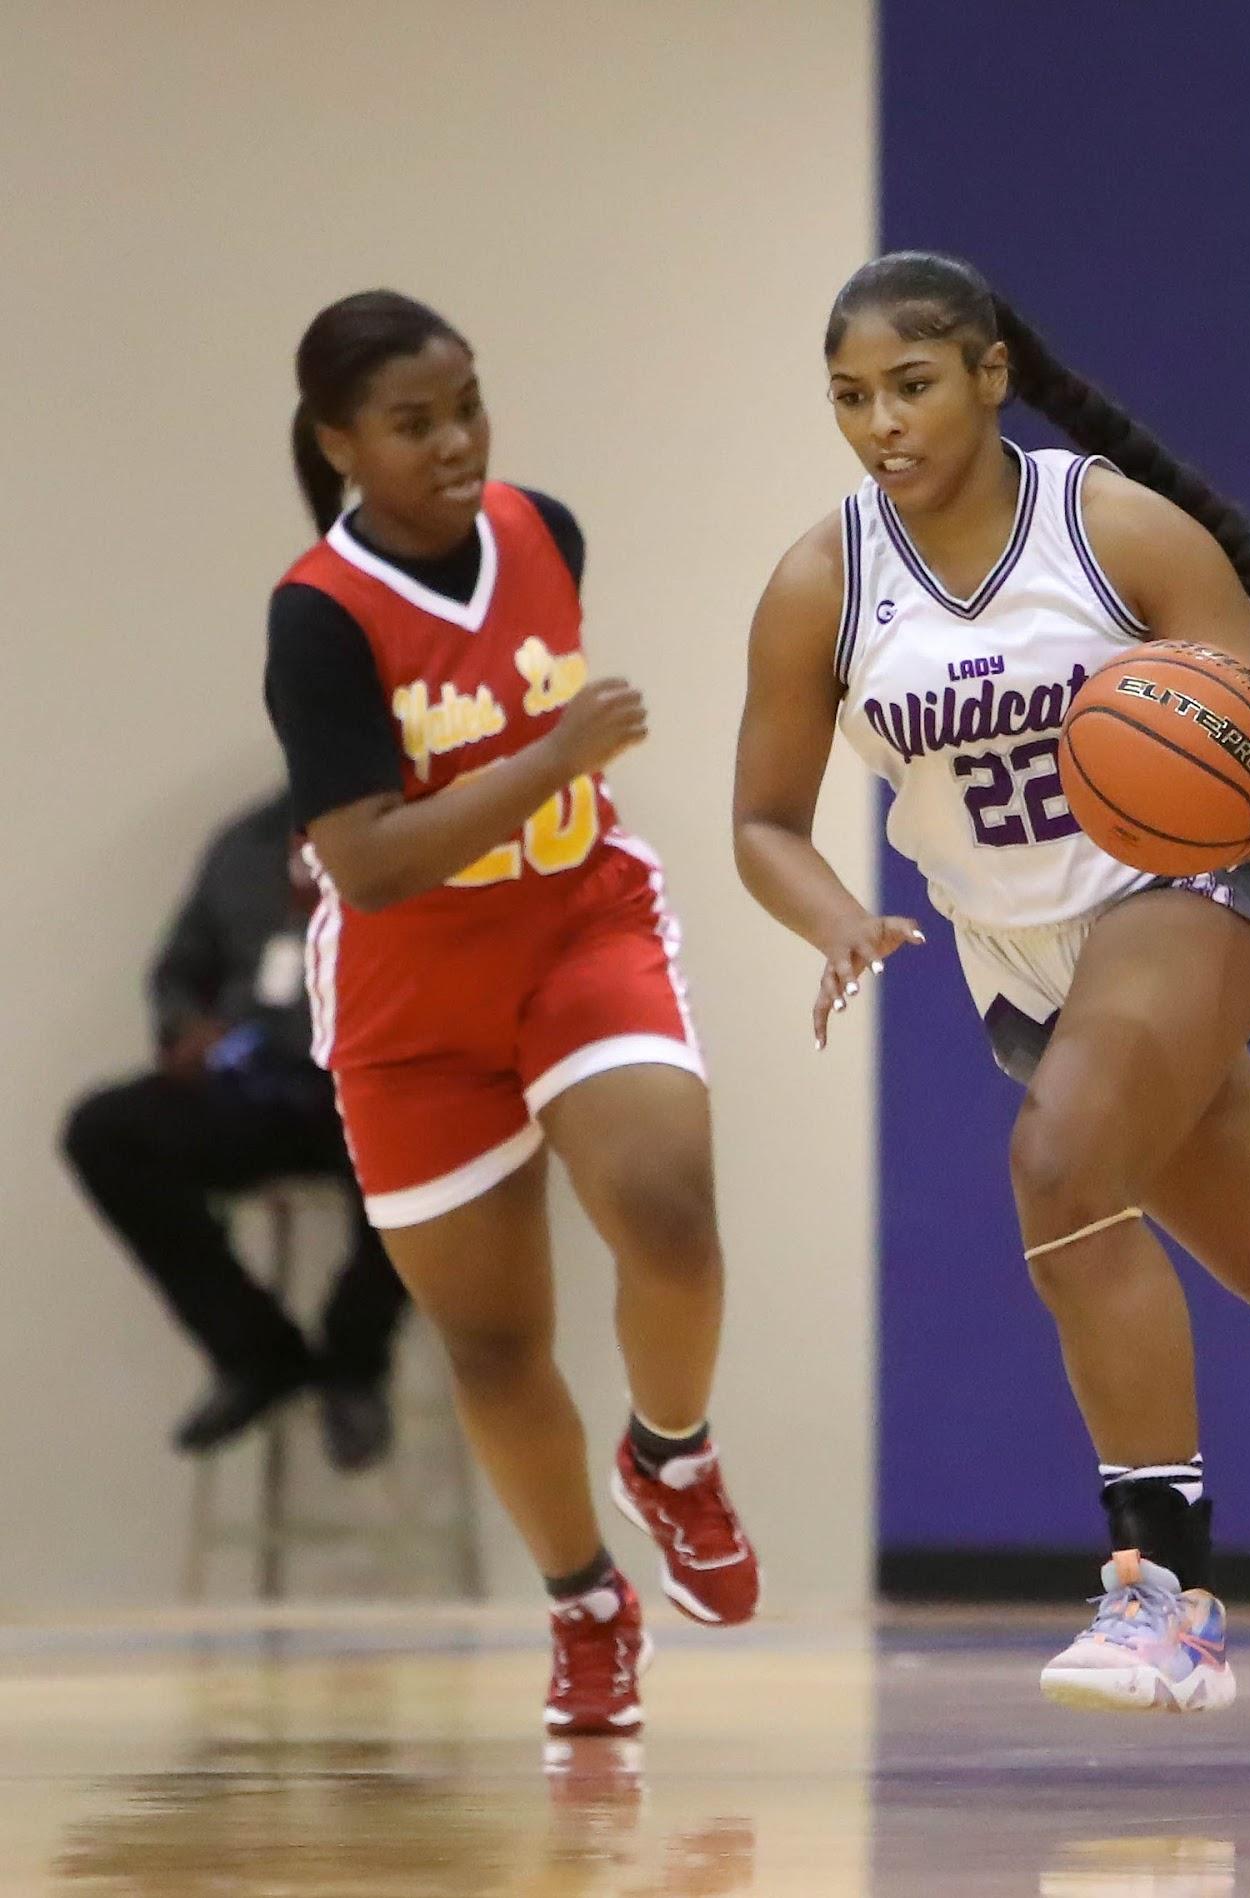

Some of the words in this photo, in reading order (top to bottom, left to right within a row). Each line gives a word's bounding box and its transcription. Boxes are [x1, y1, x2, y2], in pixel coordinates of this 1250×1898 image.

[864, 664, 1090, 763] Wildcat
[948, 655, 1005, 681] LADY
[952, 739, 1082, 849] 22
